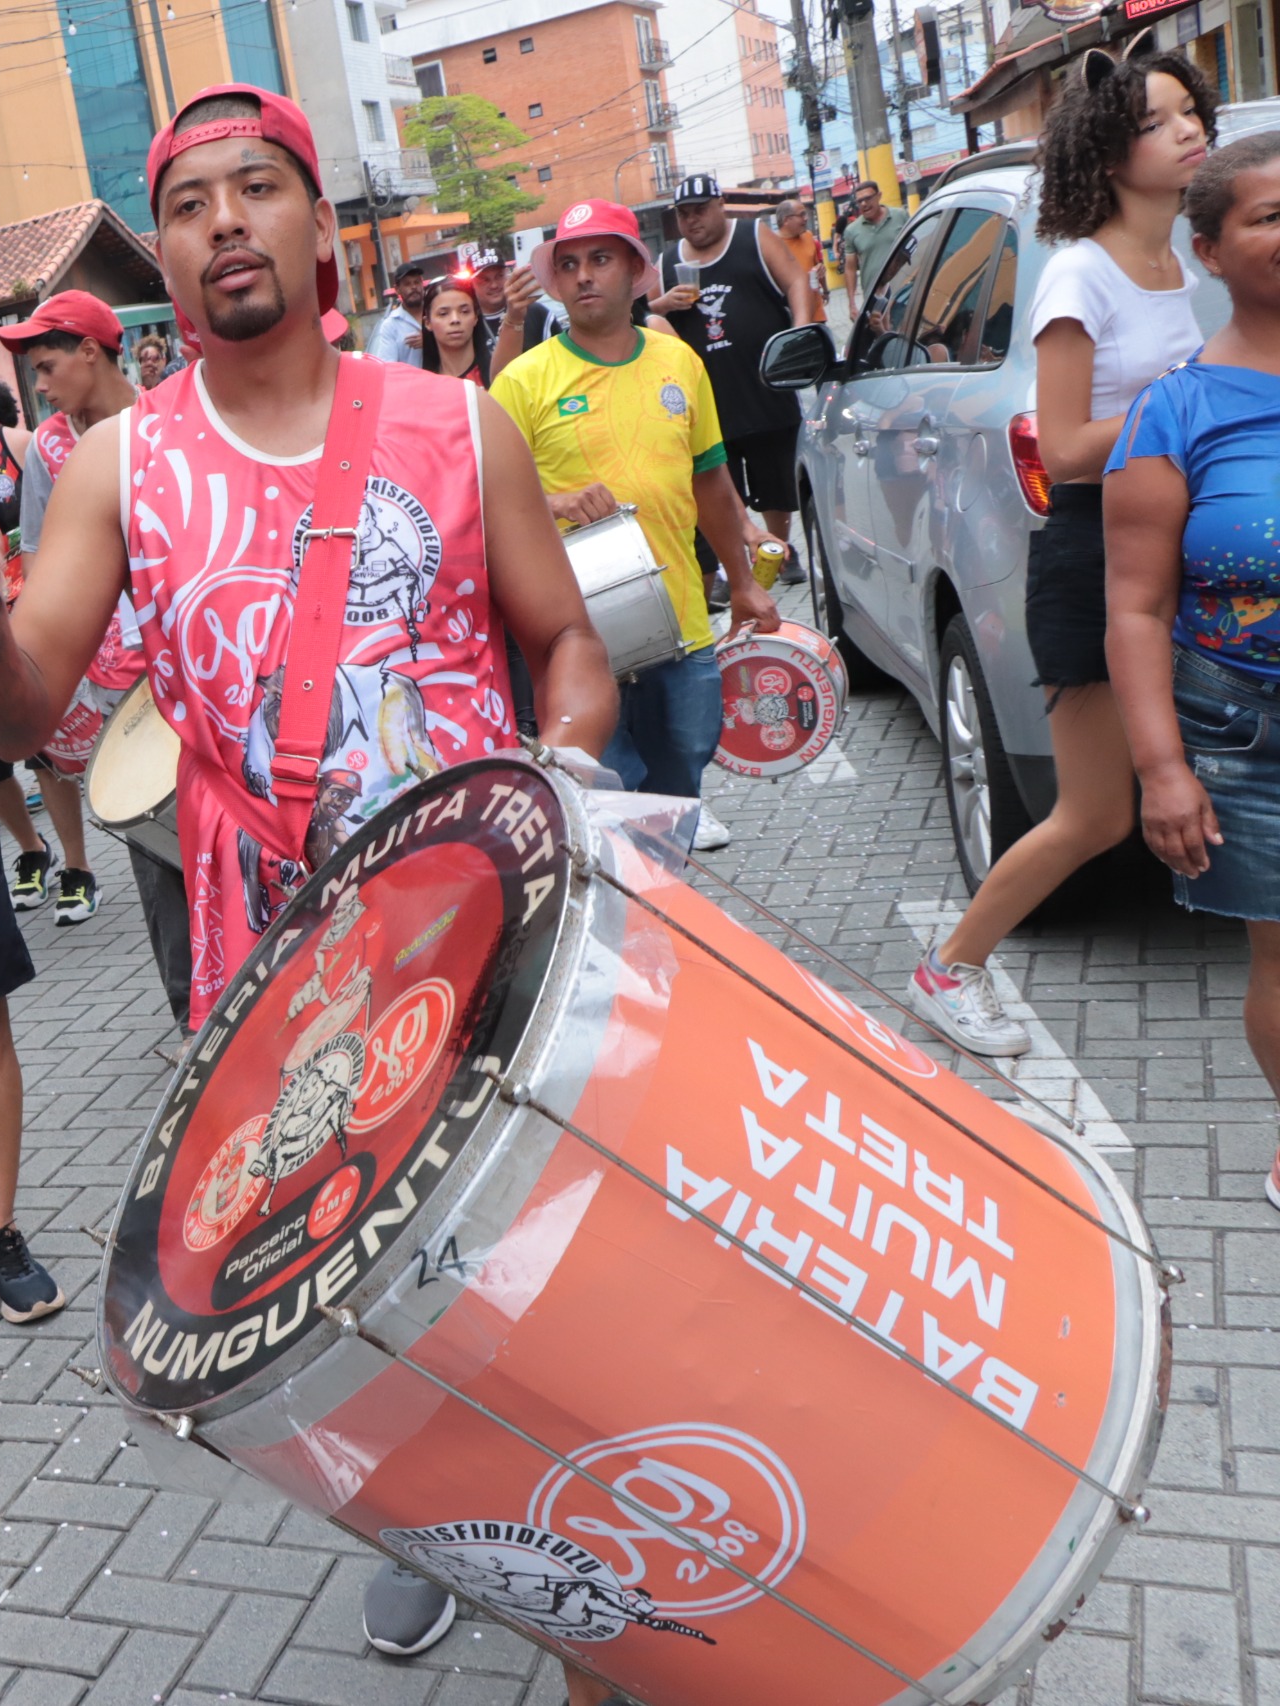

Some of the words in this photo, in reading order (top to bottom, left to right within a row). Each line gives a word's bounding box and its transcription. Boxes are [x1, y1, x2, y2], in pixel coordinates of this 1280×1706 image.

[706, 339, 732, 352] FIEL
[346, 607, 389, 623] 008
[716, 641, 762, 666] RETA
[790, 650, 836, 764] NUMGUENTU
[715, 752, 762, 777] BATE
[136, 927, 303, 1201] BATERIA
[319, 788, 470, 910] MUITA
[479, 783, 558, 925] TRETA
[370, 1058, 416, 1104] 2008
[209, 1118, 265, 1172] BATERIA
[287, 1135, 325, 1173] 2008
[747, 1037, 1015, 1262] TRETA
[123, 1055, 503, 1381] NUMGUENTU
[188, 1224, 218, 1248] MUITA
[222, 1175, 267, 1236] TRETA
[314, 1186, 354, 1220] DME
[740, 1105, 1007, 1331] MUITA
[225, 1212, 307, 1280] Parceiro
[242, 1234, 304, 1284] Oficial
[411, 1235, 468, 1290] 24
[665, 1143, 1039, 1431] BATERIA
[676, 1519, 760, 1584] 2008
[562, 1622, 616, 1640] 2008
